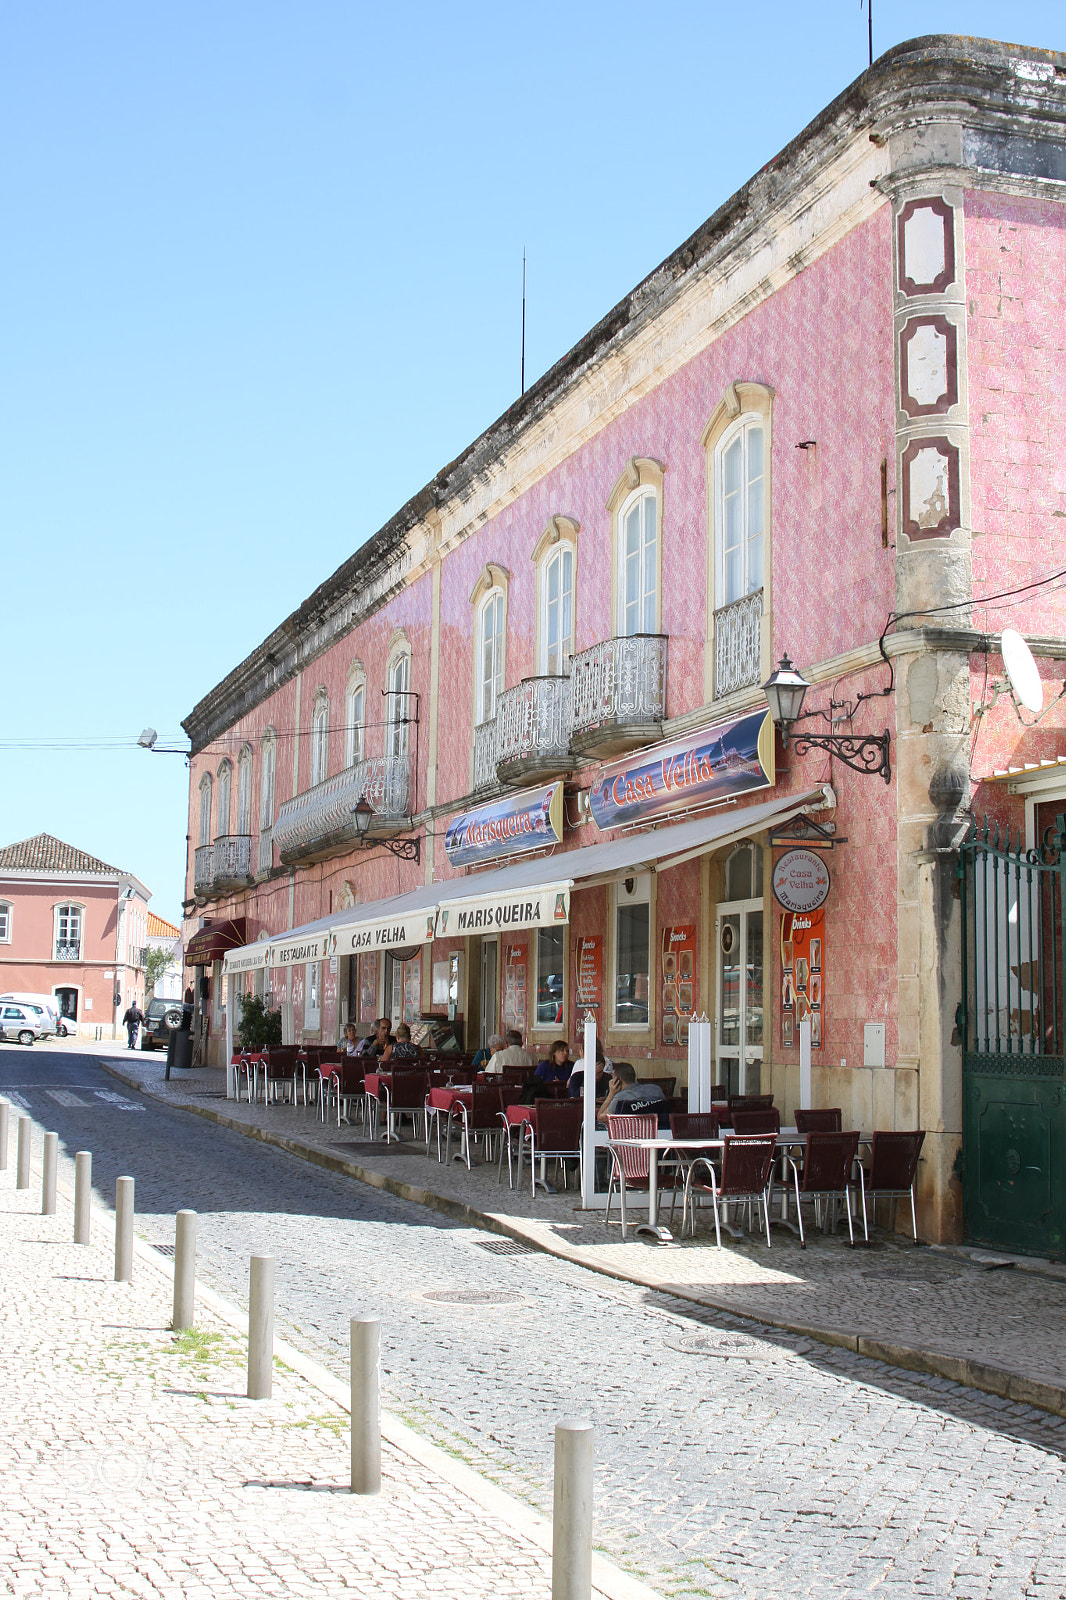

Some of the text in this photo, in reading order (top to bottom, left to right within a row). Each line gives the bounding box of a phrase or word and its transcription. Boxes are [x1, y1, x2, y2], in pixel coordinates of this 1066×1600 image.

[612, 748, 715, 807] Casa Velha
[465, 808, 533, 846] Marisqueira
[779, 854, 823, 873] Restaurante
[789, 870, 813, 878] Casa
[788, 881, 814, 889] Velha
[458, 902, 541, 928] MARISQUEIRA
[792, 917, 812, 930] Drinks
[351, 926, 406, 949] CASA VELHA
[670, 931, 687, 942] Snacks
[279, 943, 319, 963] RESTAURANTE
